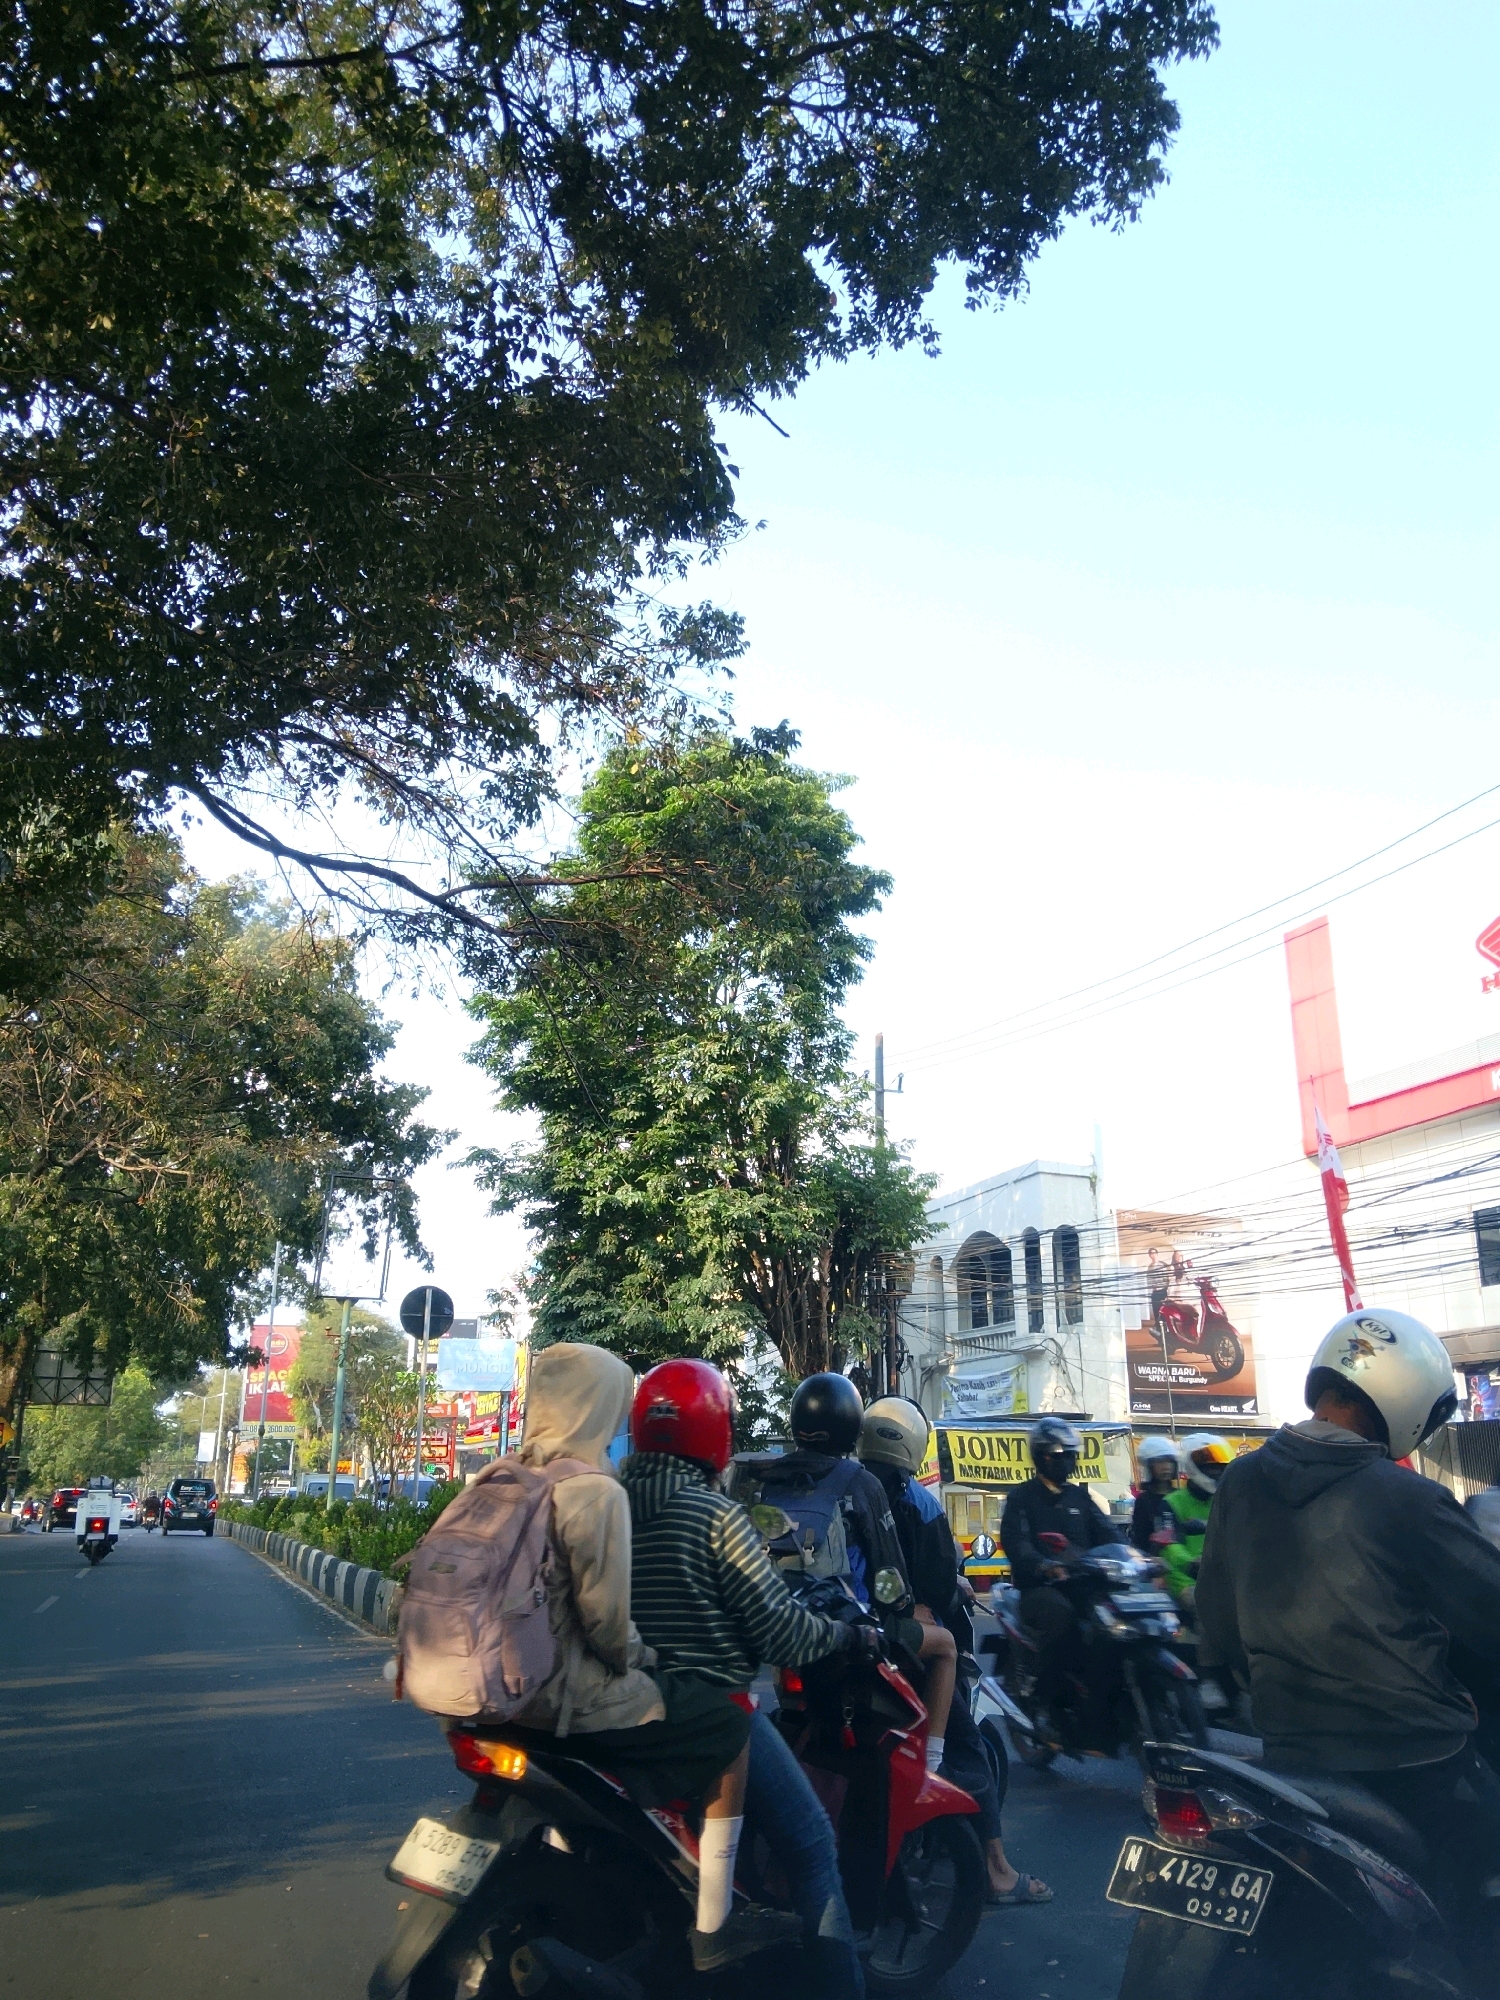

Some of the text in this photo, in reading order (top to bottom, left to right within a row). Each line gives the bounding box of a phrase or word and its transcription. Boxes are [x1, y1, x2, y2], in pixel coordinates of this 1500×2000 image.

[249, 1369, 291, 1383] SPAC
[457, 1363, 511, 1374] MUNGIL
[1137, 1366, 1195, 1376] WARNA BARU
[1148, 1375, 1208, 1385] SPECAL Burgundy
[954, 1435, 1029, 1462] JOINT
[959, 1463, 1013, 1480] MARTABAK
[1015, 1471, 1021, 1480] &
[1155, 1771, 1190, 1786] YAMAHA
[422, 1830, 460, 1856] 5289
[1124, 1845, 1263, 1903] N 4129 GA
